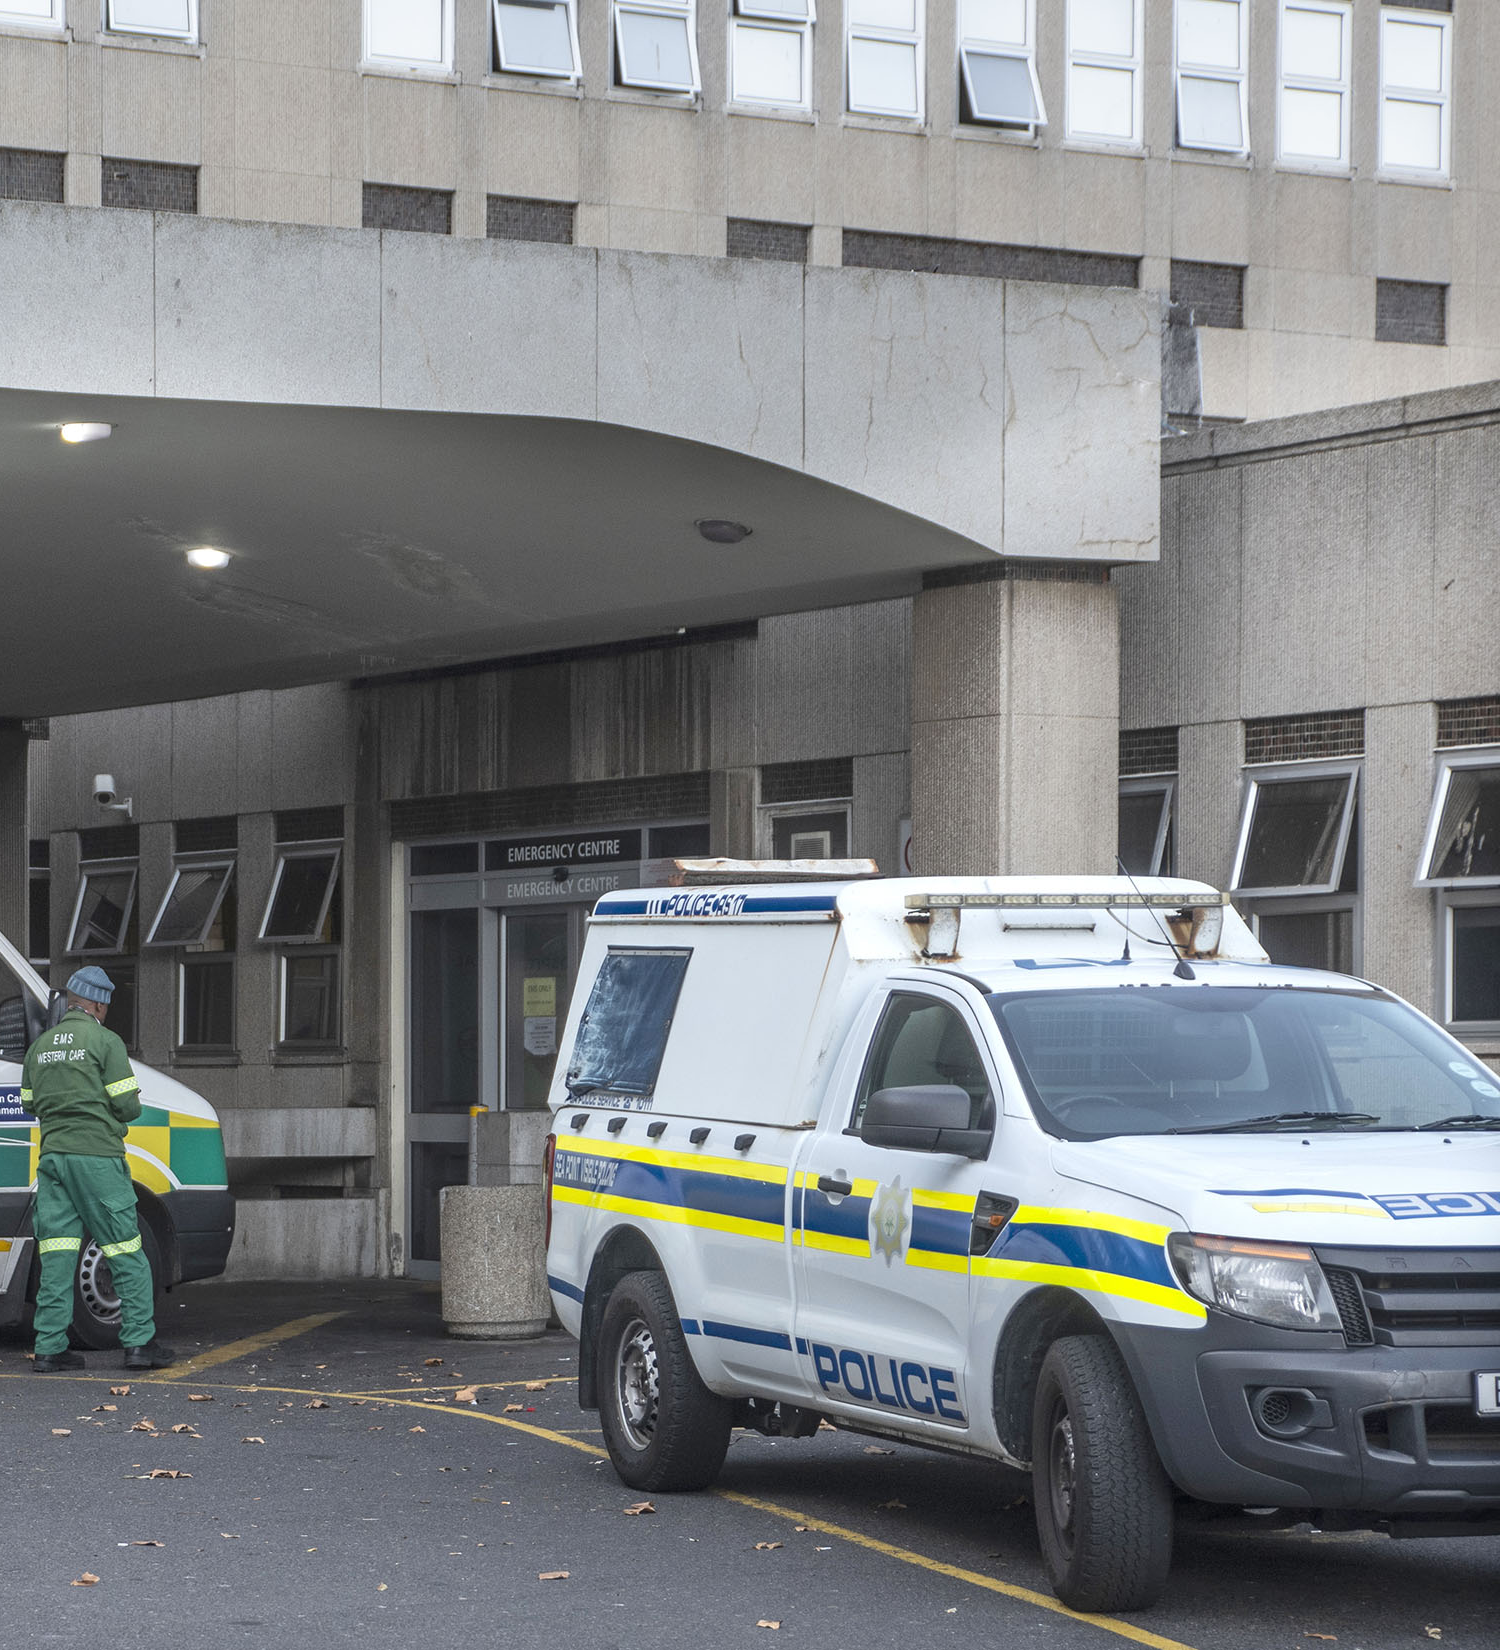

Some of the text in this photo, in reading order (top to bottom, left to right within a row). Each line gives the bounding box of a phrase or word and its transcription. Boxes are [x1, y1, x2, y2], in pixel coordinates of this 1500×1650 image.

[508, 839, 620, 863] EMERGENCY CENTRE
[507, 876, 619, 898] EMERGENCY CENTRE
[665, 894, 717, 916] POLICE
[53, 1033, 74, 1045] EMS
[37, 1049, 86, 1064] WESTERN CAPE
[812, 1343, 966, 1422] POLICE
